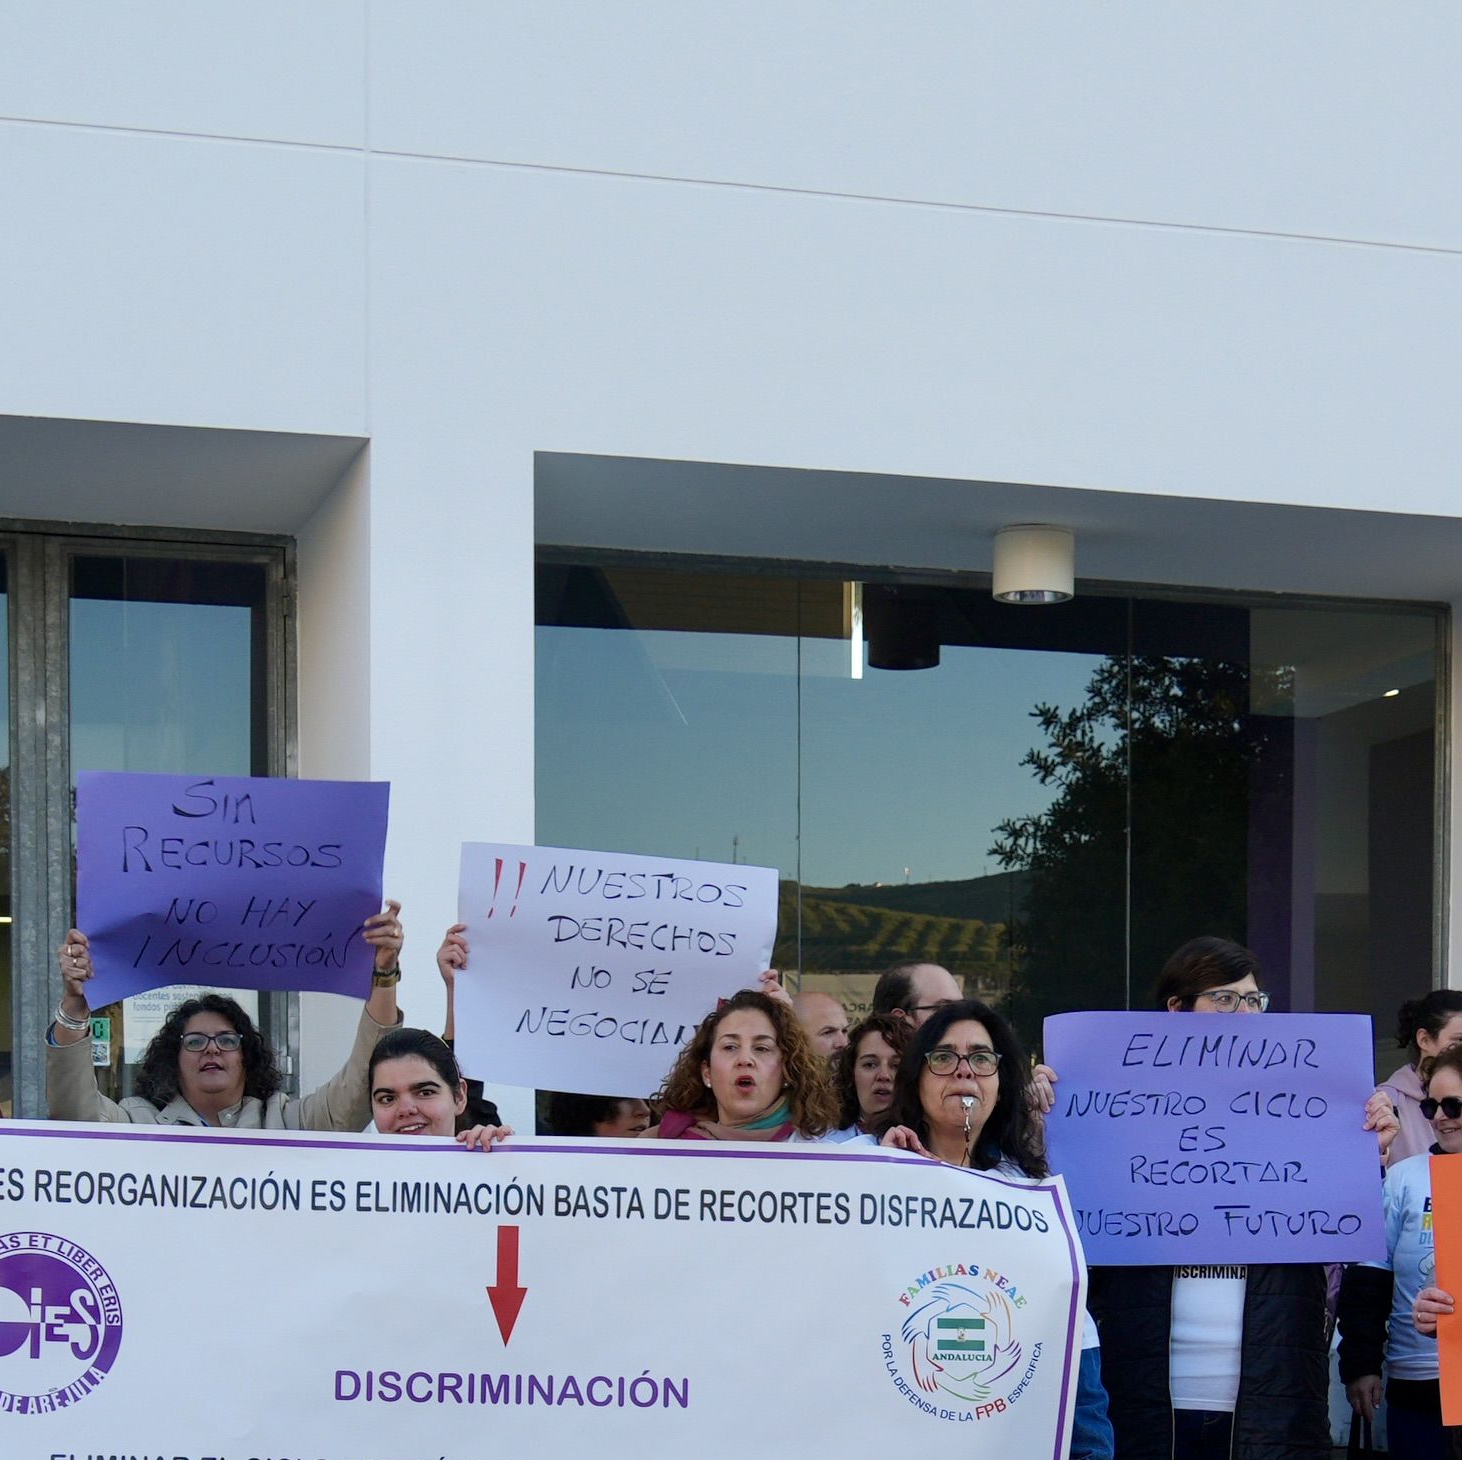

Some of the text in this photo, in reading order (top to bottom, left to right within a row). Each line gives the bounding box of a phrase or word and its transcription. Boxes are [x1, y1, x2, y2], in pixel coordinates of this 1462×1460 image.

[123, 826, 343, 872] RECURSOS
[540, 865, 747, 908] NUESTROS
[164, 896, 316, 928] NO HAY
[133, 926, 363, 968] INCLUSIÓN
[548, 915, 737, 956] DERECHOS
[571, 966, 672, 995] NO SE
[515, 1007, 700, 1045] NEGOCIAN
[1122, 1034, 1319, 1069] ELIMINAR
[1065, 1090, 1328, 1119] NUESTRO CICLO
[1179, 1126, 1226, 1152] ES
[1130, 1155, 1307, 1185] RECORTAR
[34, 1170, 301, 1211] REORGANIZACIÓN
[311, 1181, 346, 1211] ES
[355, 1177, 545, 1217] ELIMINACIÓN
[554, 1184, 645, 1219] BASTA
[654, 1188, 690, 1221] DE
[699, 1189, 851, 1226] RECORTES
[860, 1193, 1050, 1234] DISFRAZADOS
[1213, 1205, 1362, 1236] FUTURO
[28, 1235, 52, 1249] ET
[57, 1241, 104, 1281] LIBER
[99, 1284, 120, 1325] ERIS
[899, 1264, 1027, 1309] FAMILIAS NEAE
[1175, 1265, 1247, 1280] ISCRIMINA
[932, 1353, 993, 1362] ANDALUCIA
[334, 1370, 689, 1408] DISCRIMINACIÓN
[882, 1334, 1043, 1421] POR LA DEFENSA DE LA FPB ESPECIFICA
